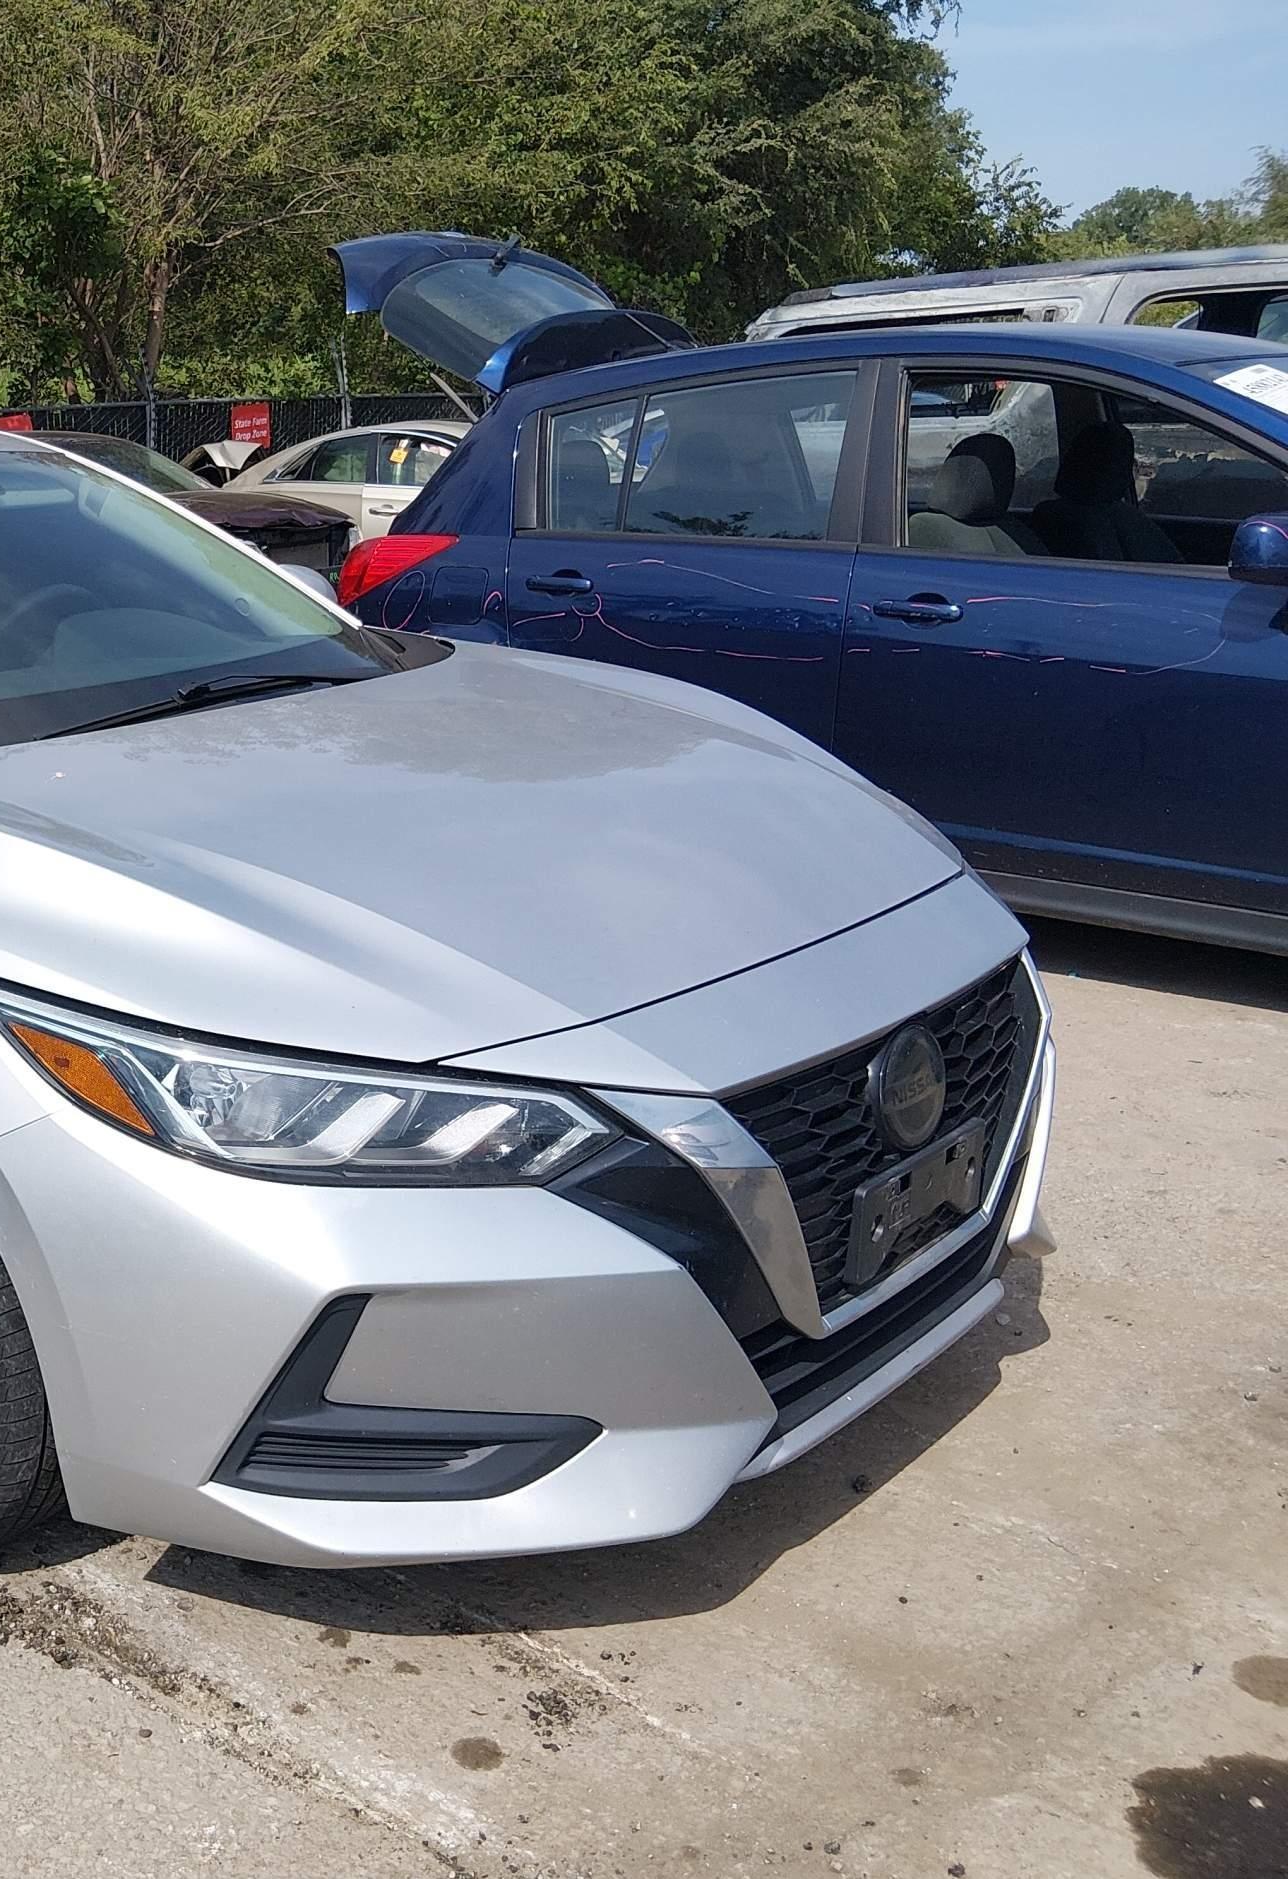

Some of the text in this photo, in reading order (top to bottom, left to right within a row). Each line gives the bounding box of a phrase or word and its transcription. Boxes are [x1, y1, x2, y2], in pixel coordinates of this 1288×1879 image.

[234, 417, 267, 429] State Farm
[235, 429, 267, 441] Drop Zone
